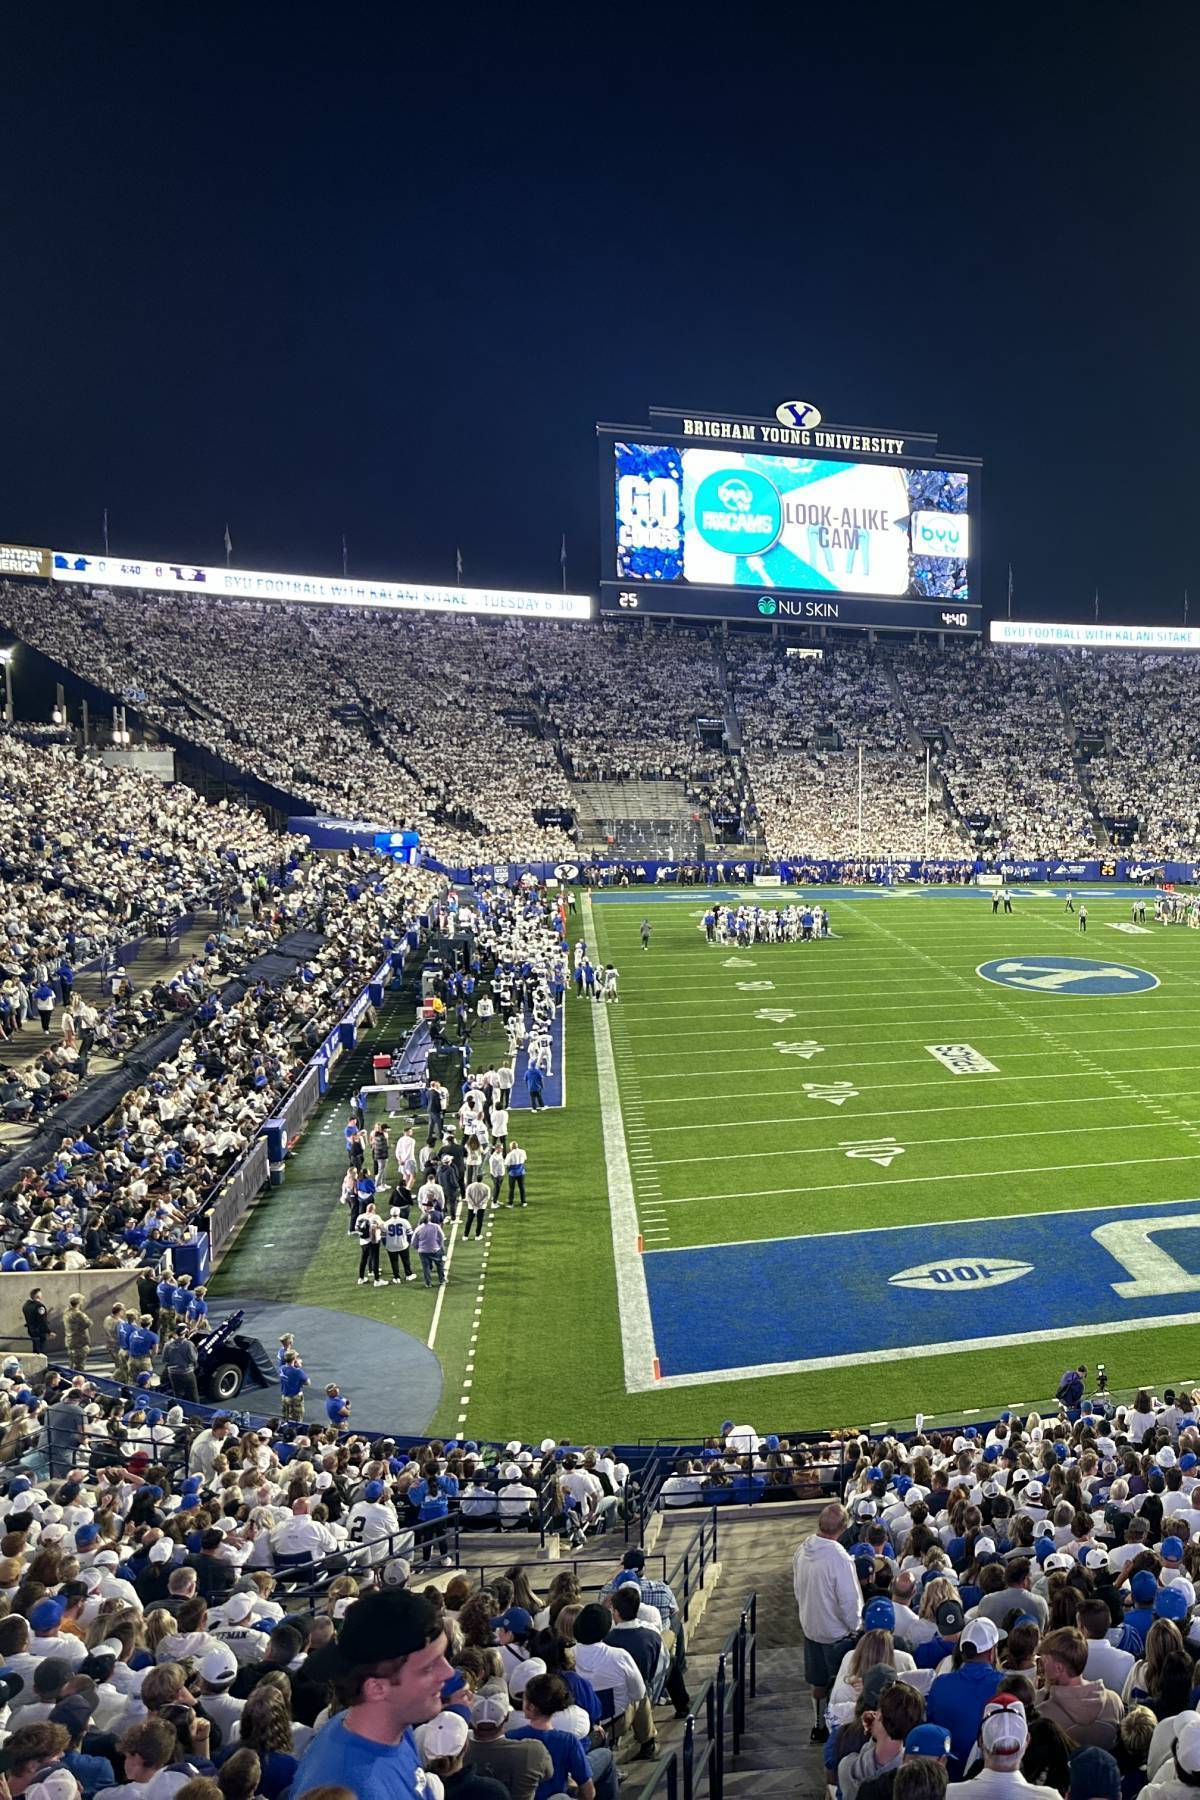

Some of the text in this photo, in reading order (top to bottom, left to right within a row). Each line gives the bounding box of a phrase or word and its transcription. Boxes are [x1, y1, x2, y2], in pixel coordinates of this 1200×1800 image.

[785, 405, 815, 427] Y
[683, 419, 905, 455] BRIGHAM YOUNG UNIVERSITY
[619, 475, 679, 528] GO
[786, 502, 889, 531] LOOK-ALIKE
[818, 527, 859, 550] CAM
[922, 525, 960, 544] byu
[0, 558, 40, 574] ERICA
[120, 565, 141, 576] 4:40
[224, 576, 252, 589] BYU
[256, 577, 324, 594] FOOTBALL
[331, 586, 365, 598] WITH
[370, 589, 419, 601] KALANI
[423, 592, 467, 605] SITAKE
[484, 596, 540, 610] TUESDAY
[619, 592, 639, 608] 25
[779, 600, 839, 618] NU SKIN
[941, 612, 968, 627] 4:40
[1004, 626, 1025, 637] BYU
[1028, 626, 1080, 640] FOOTBALL
[1086, 629, 1112, 641] WITH
[1116, 631, 1153, 642] KALANI
[1158, 631, 1192, 643] SITAKE
[773, 1040, 825, 1055] 30
[802, 1081, 860, 1100] 20
[838, 1137, 906, 1158] 10
[388, 1223, 404, 1237] 96
[929, 1265, 989, 1284] 100
[351, 1516, 366, 1542] 2
